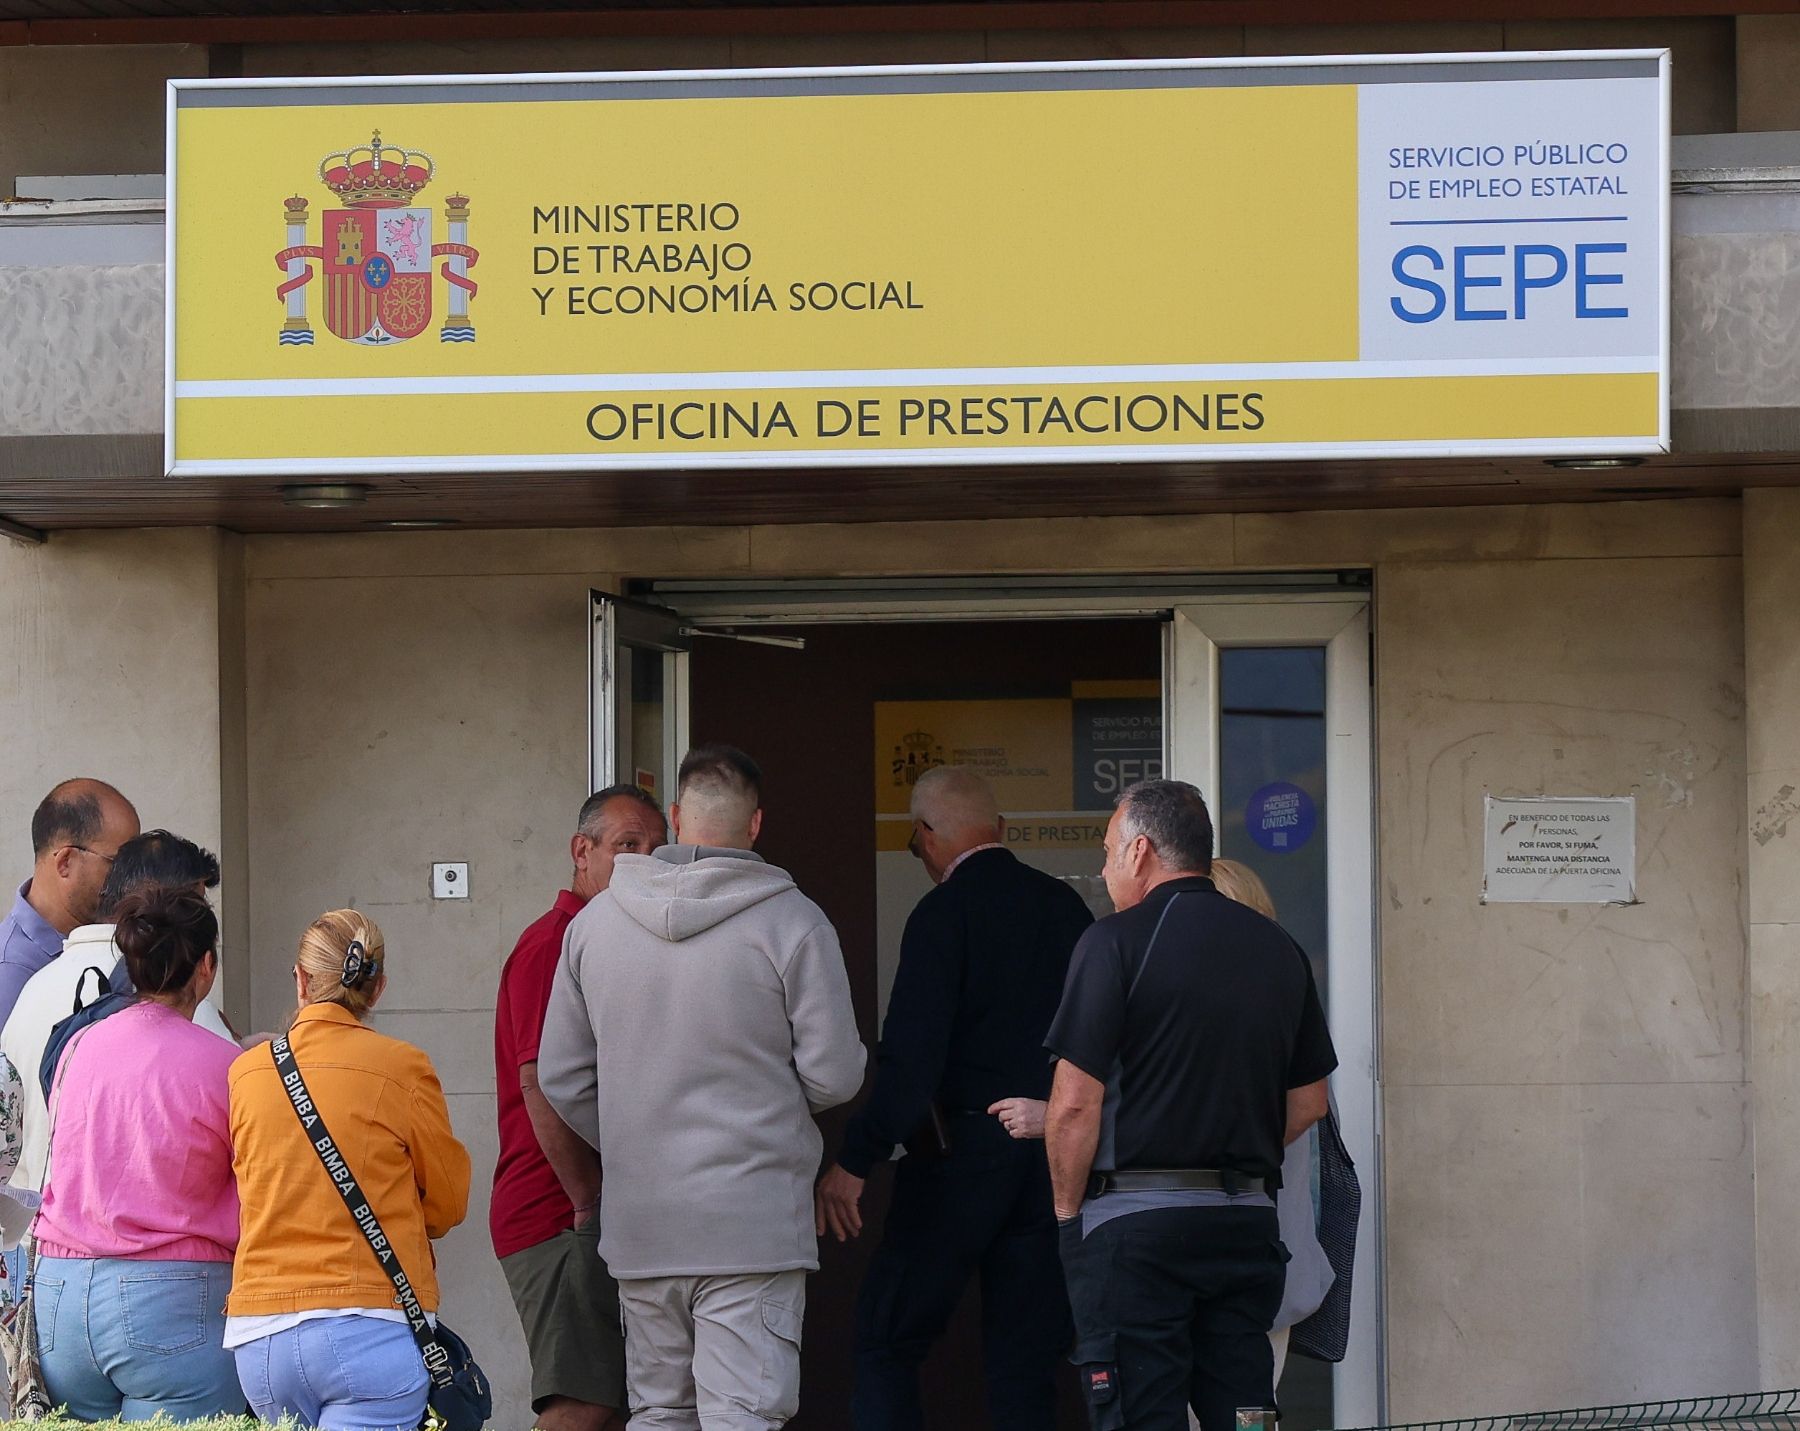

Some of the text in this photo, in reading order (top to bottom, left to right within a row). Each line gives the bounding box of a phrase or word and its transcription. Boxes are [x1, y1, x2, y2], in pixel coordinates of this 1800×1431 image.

[1389, 139, 1629, 169] SERVICIO PÚBLICO
[1389, 175, 1629, 199] DE EMPLEO ESTATAL
[532, 202, 740, 234] MINISTERIO
[532, 242, 752, 281] DE TRABAJO
[531, 276, 924, 316] Y ECONOMÍA SOCIAL
[1390, 242, 1629, 324] SEPE
[585, 392, 1266, 441] OFICINA DE PRESTACIONES
[1093, 758, 1162, 794] SEP
[1262, 814, 1299, 830] UNIDAS
[1520, 814, 1558, 822] BENEFICIO
[1571, 814, 1596, 822] TODAS
[1597, 814, 1610, 822] LAS
[1007, 826, 1031, 842] DE
[1519, 841, 1599, 849] POR FAVOR, SI FUMA,
[1590, 867, 1622, 875] OFICINA
[283, 1070, 318, 1129] BIMBA
[315, 1136, 356, 1197] BIMBA
[353, 1203, 393, 1264] BIMBA
[393, 1271, 426, 1333] BIMBA
